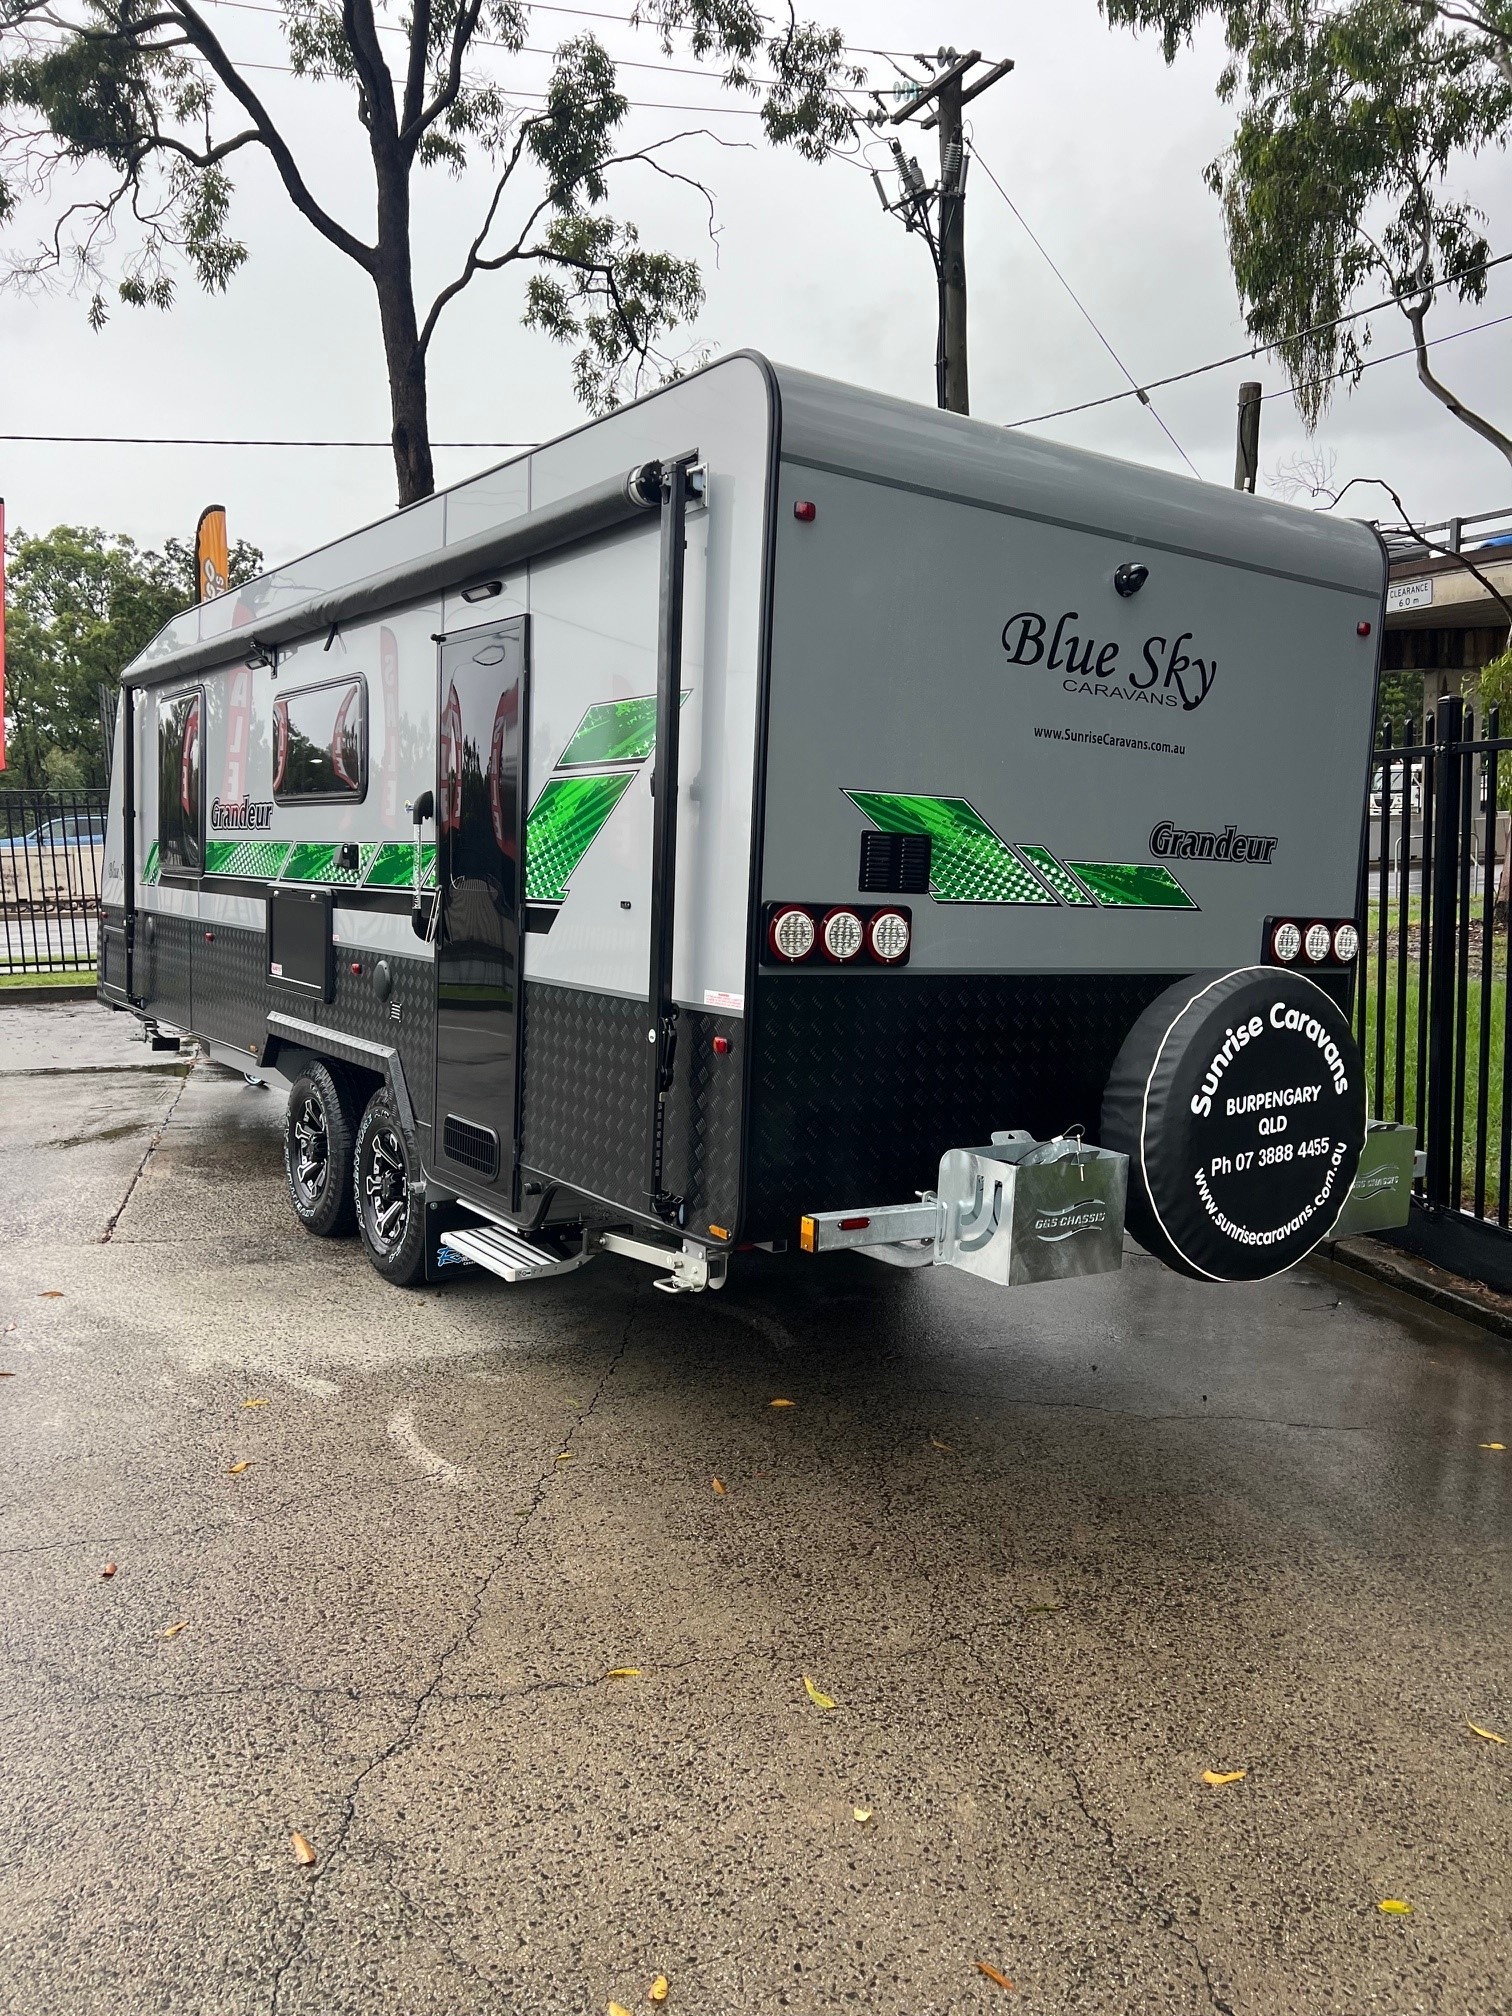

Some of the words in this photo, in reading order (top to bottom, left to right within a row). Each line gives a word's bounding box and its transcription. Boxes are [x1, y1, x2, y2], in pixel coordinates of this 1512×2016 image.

[1390, 583, 1428, 598] CLEARANCE
[1002, 612, 1119, 678] Blue
[1129, 632, 1217, 711] Sky
[1063, 679, 1178, 708] CARAVANS
[1034, 725, 1186, 755] www.SunriseCaravans.com.au
[211, 794, 274, 830] Grandeur
[1149, 820, 1278, 865] Grandeur
[1191, 1016, 1264, 1117] Sunrise
[1270, 1002, 1349, 1095] Caravans
[1226, 1084, 1322, 1116] BURPENGARY
[1258, 1115, 1288, 1136] QLD
[1211, 1156, 1232, 1177] Ph
[1235, 1151, 1254, 1171] 07
[1258, 1143, 1294, 1167] 3888
[1297, 1136, 1330, 1158] 4455
[1194, 1142, 1348, 1246] www.sunrisecaravans.com.au
[1059, 1212, 1106, 1227] CHASSIS
